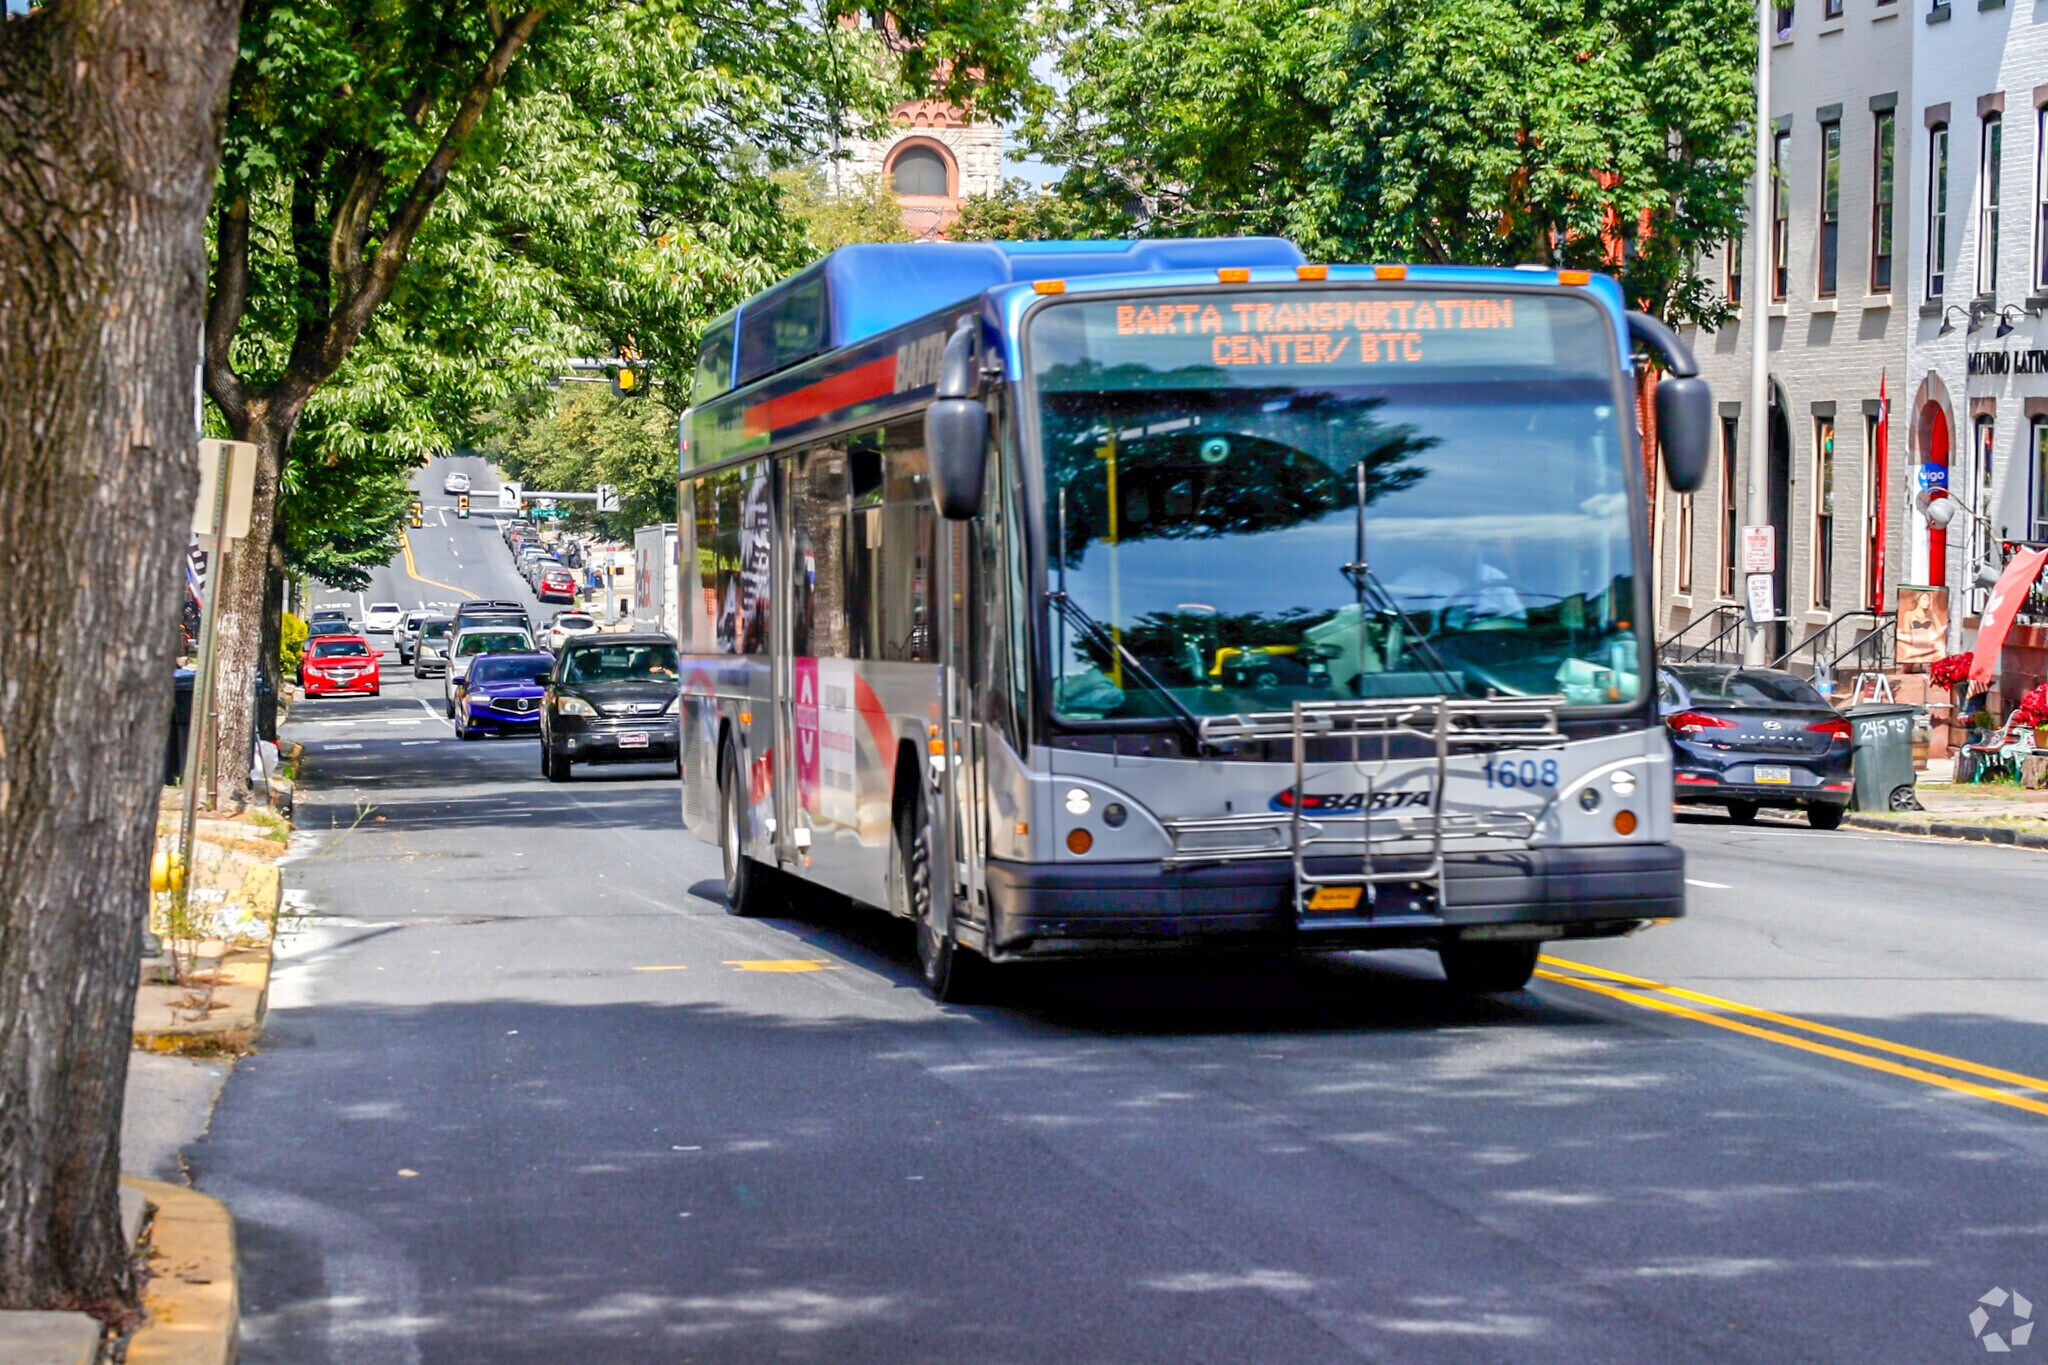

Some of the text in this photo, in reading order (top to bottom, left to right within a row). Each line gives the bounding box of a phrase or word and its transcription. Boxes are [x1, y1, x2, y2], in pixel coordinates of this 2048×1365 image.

[1117, 299, 1513, 335] BARTA TRANSPORTATION
[1211, 332, 1423, 365] CENTER/ BTC
[1968, 352, 2010, 375] MUNDO
[1919, 469, 1945, 483] vigo
[1860, 719, 1888, 739] 245
[1482, 758, 1559, 789] 1608
[1320, 791, 1432, 809] BARTA
